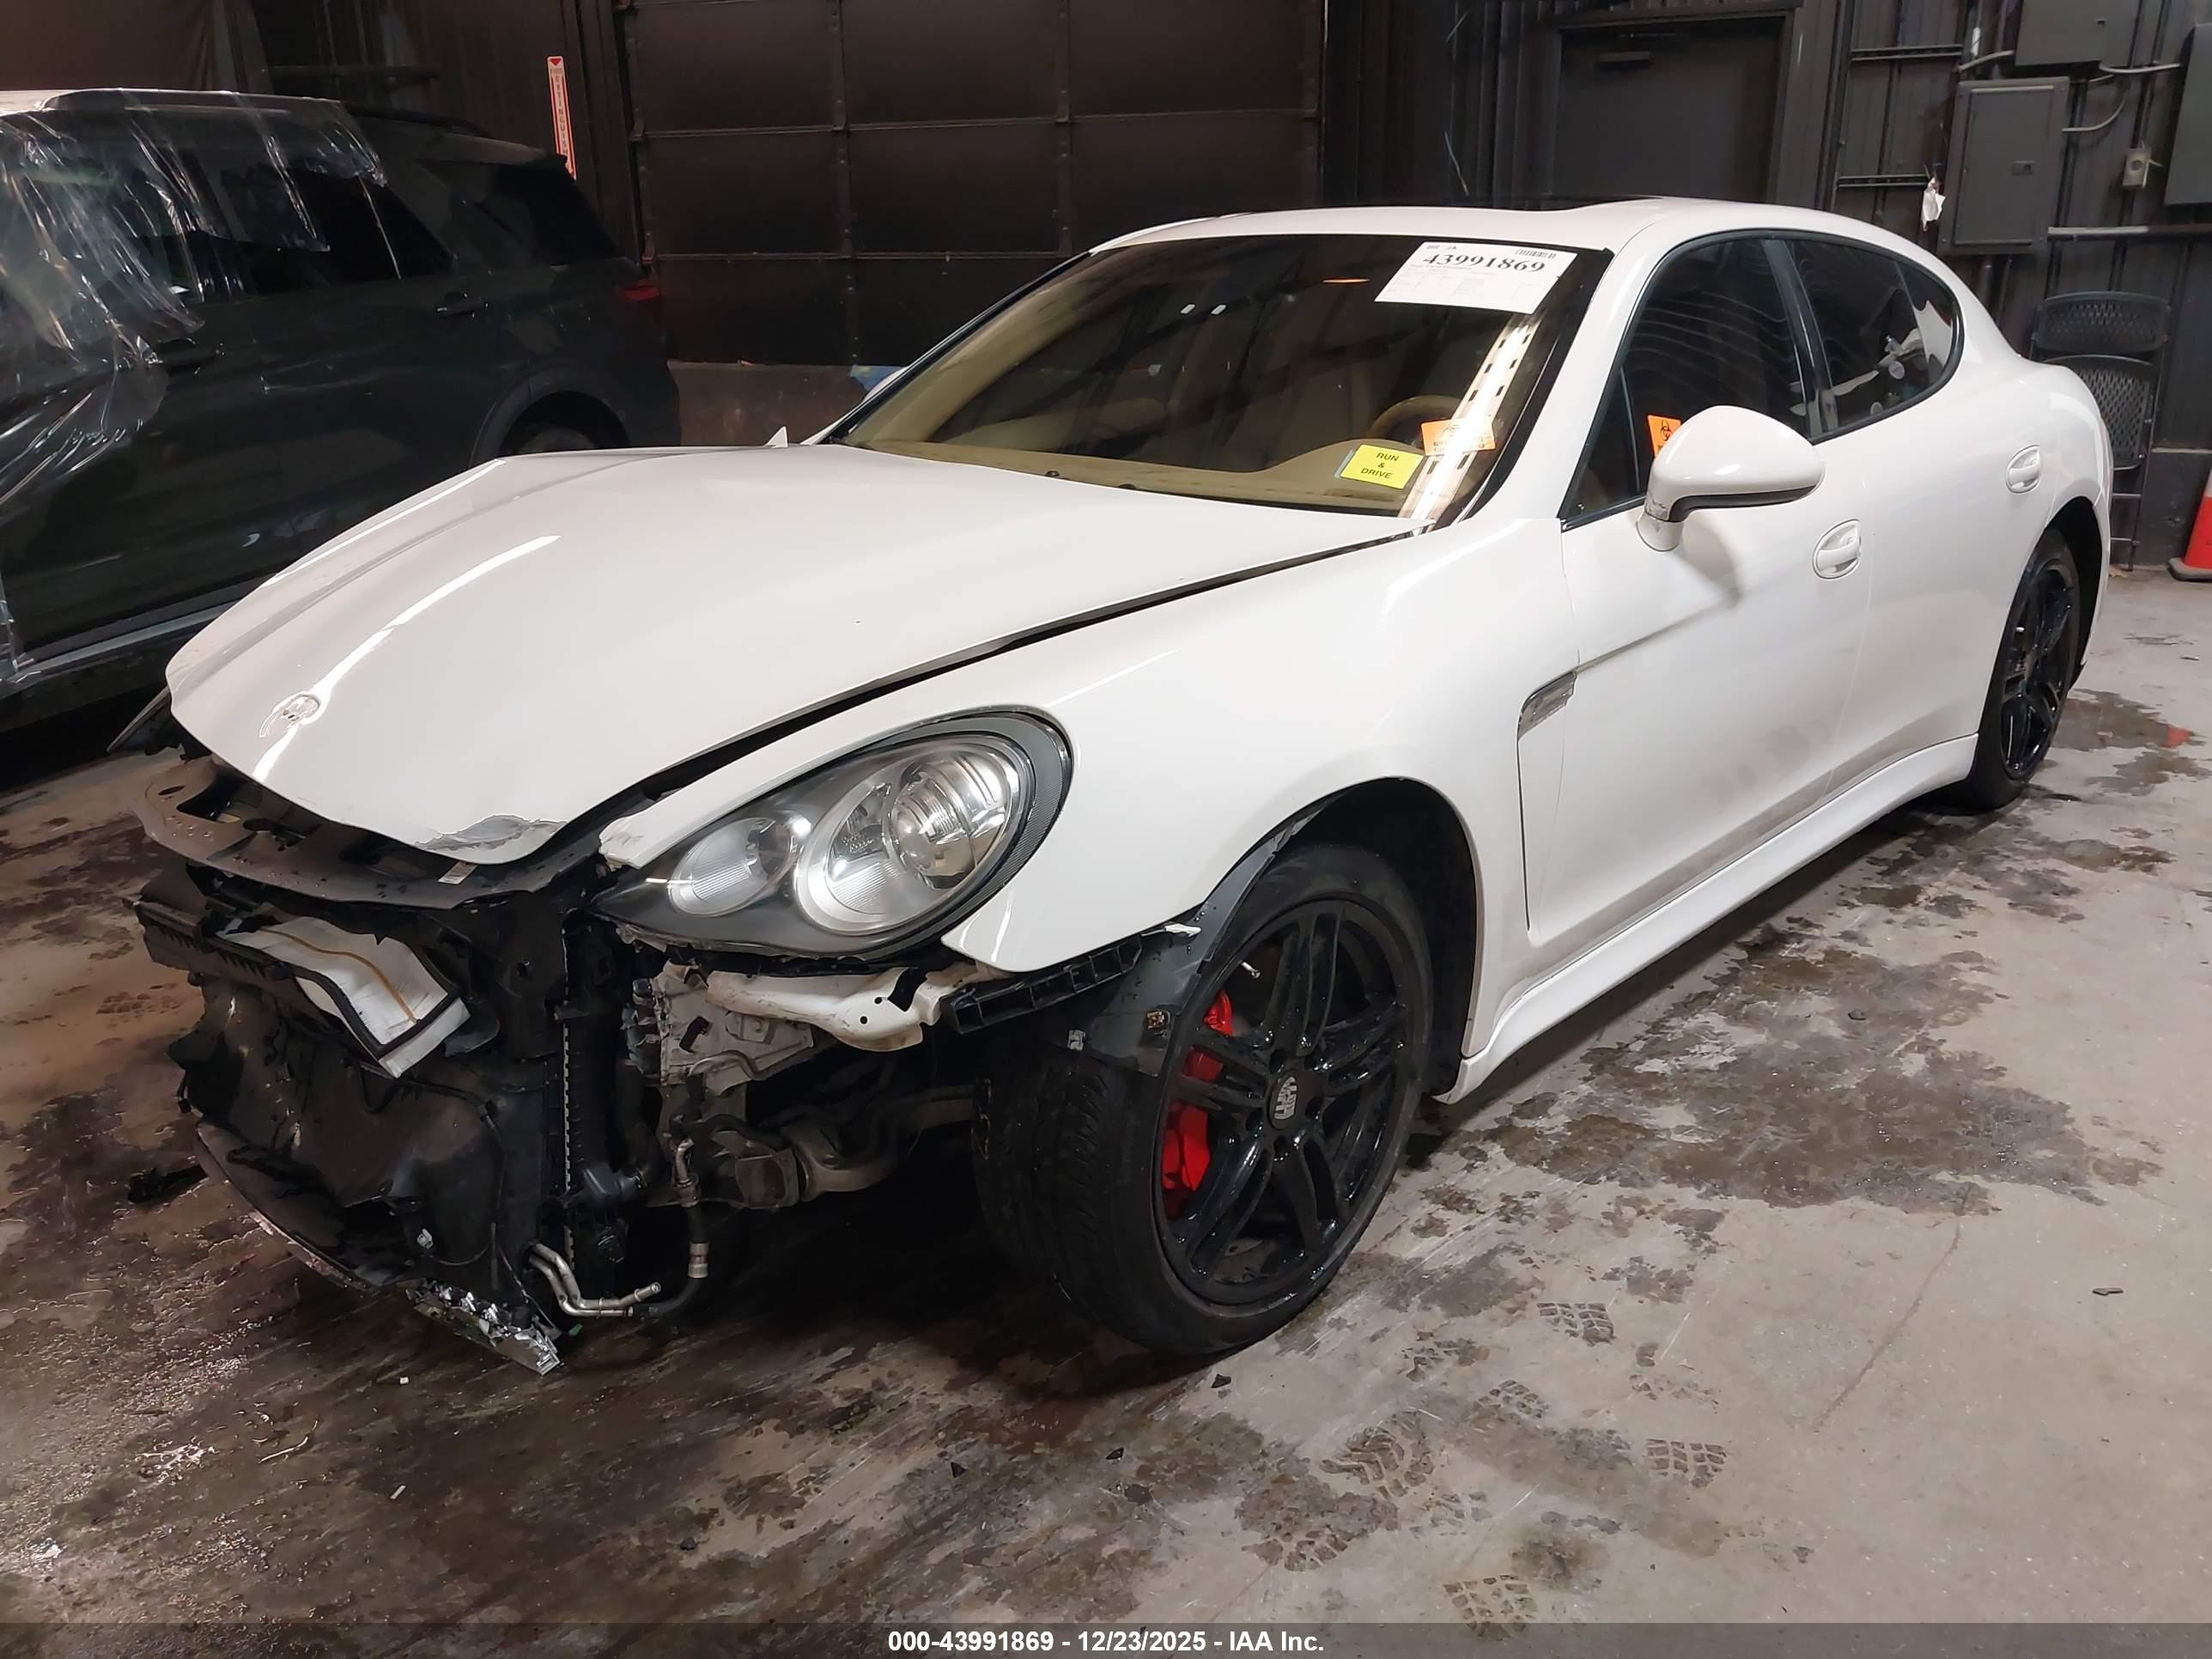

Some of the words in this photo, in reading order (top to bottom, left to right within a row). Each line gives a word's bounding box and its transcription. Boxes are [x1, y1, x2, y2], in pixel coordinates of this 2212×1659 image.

[1423, 253, 1546, 273] 43991869
[1376, 453, 1399, 462] RUN
[1360, 468, 1392, 478] DRIVE
